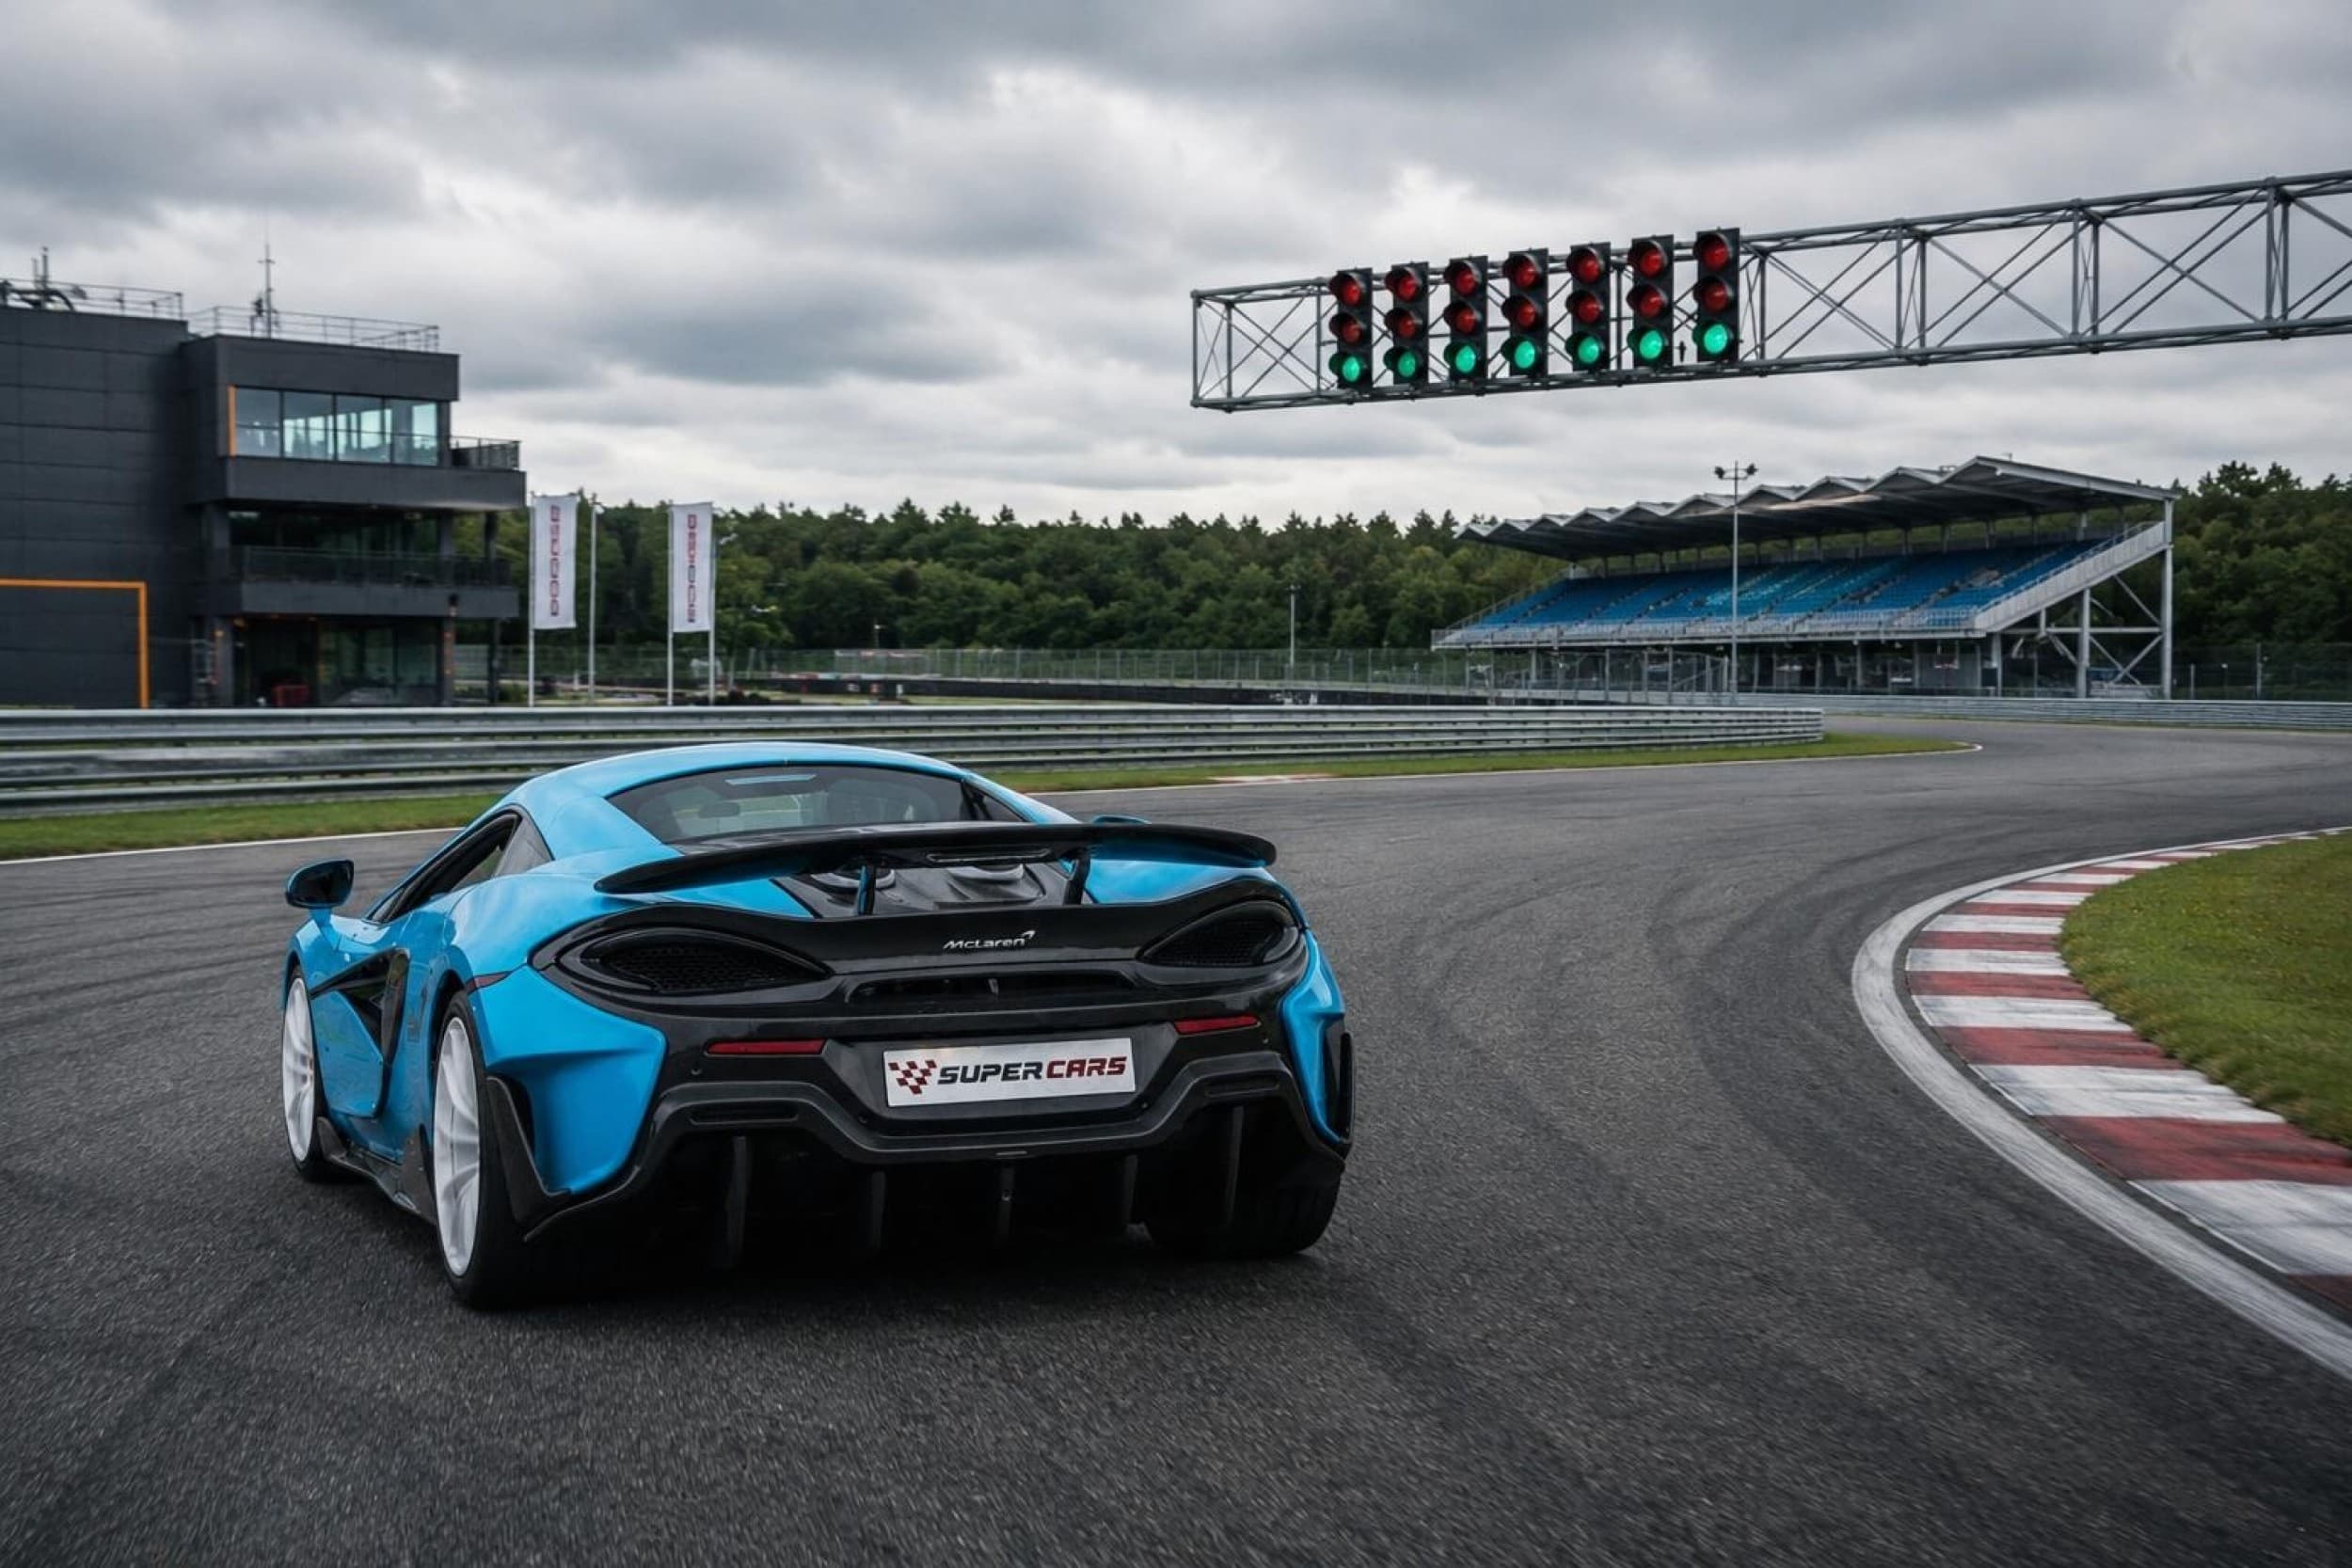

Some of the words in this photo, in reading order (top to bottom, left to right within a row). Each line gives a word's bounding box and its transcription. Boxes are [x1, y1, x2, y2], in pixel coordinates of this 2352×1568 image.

[943, 937, 1026, 949] McLaren
[937, 1061, 1043, 1085] SUPER
[1046, 1056, 1127, 1079] CARS
